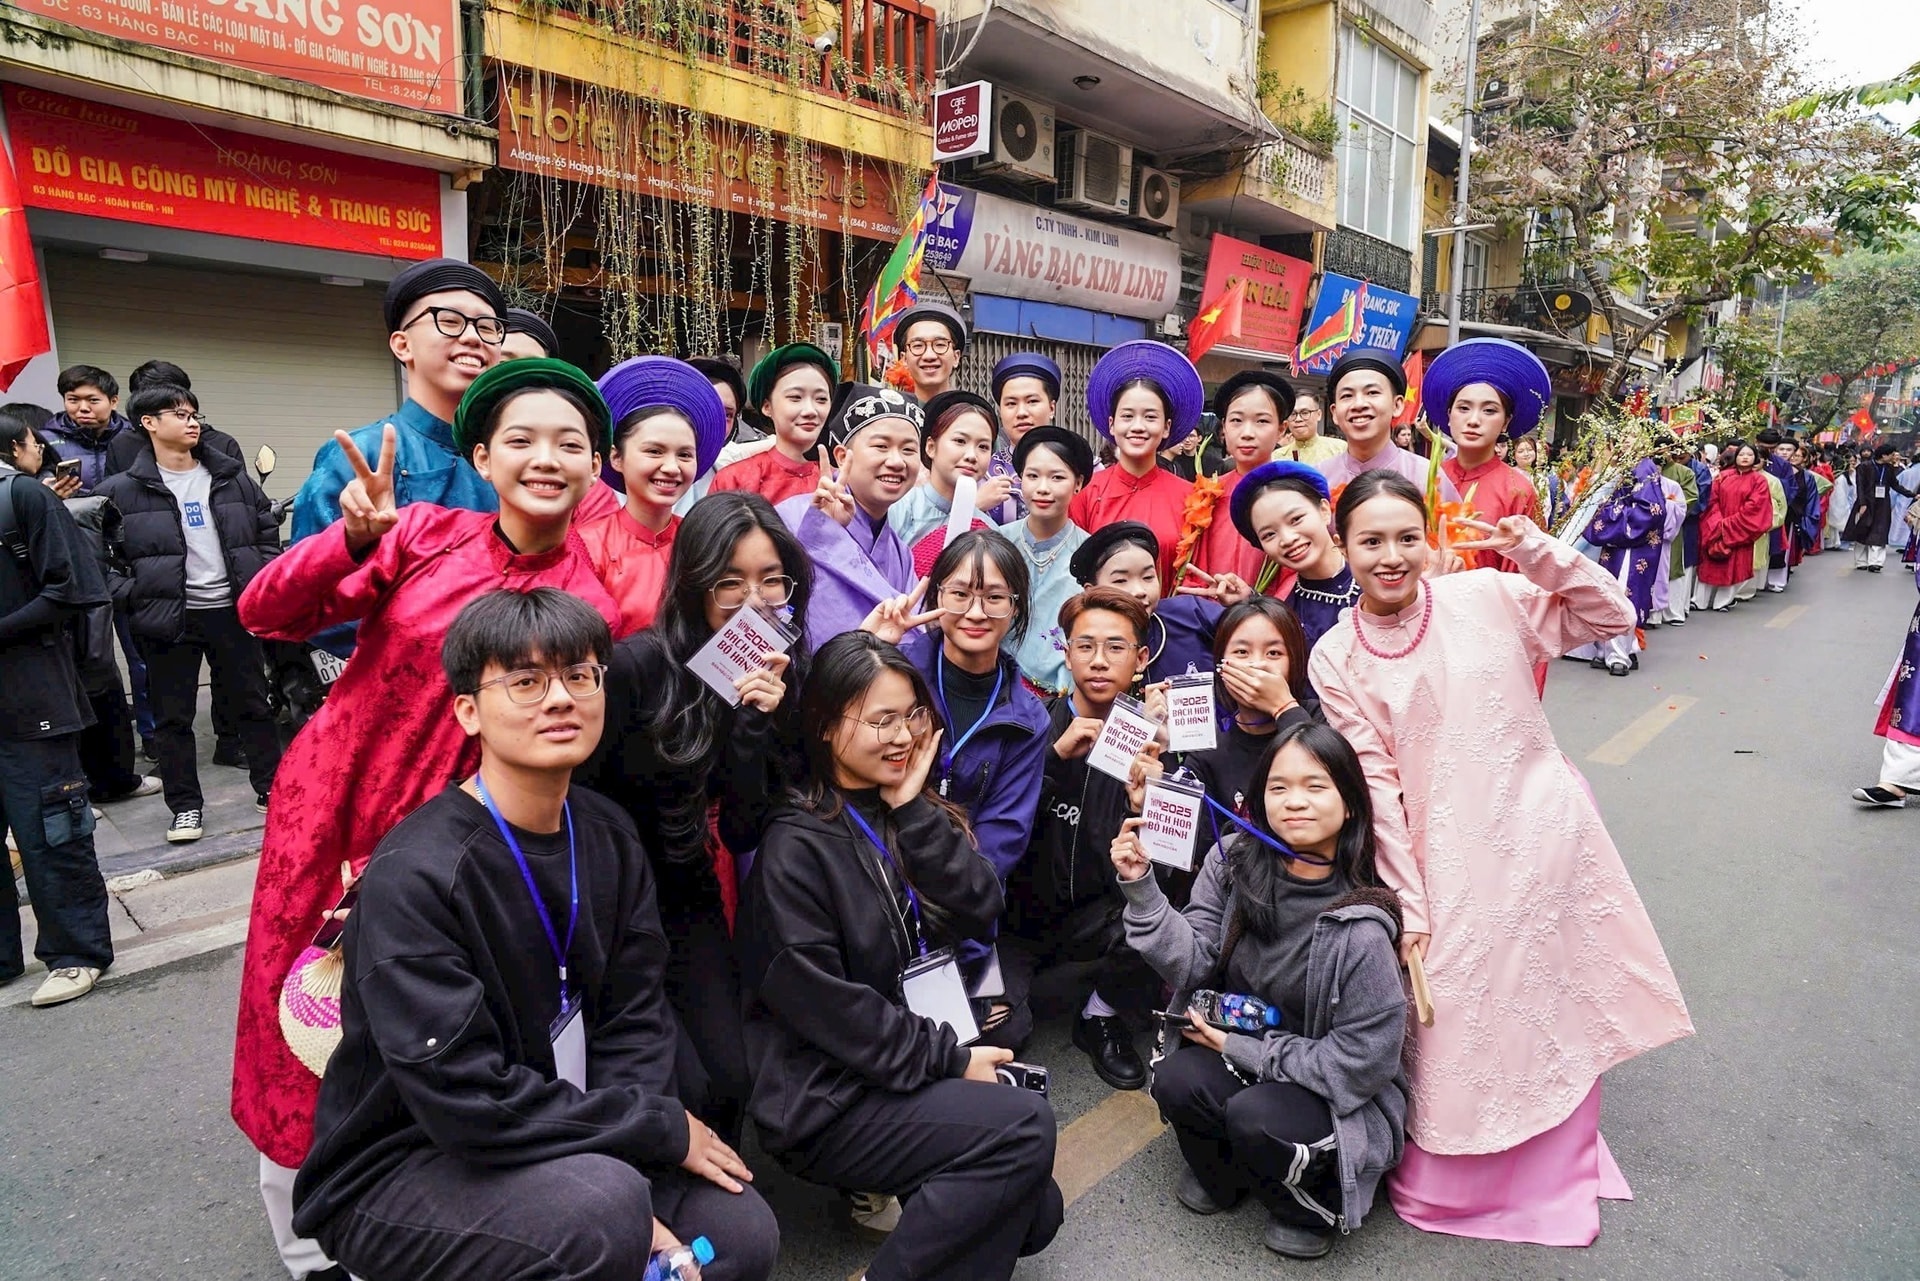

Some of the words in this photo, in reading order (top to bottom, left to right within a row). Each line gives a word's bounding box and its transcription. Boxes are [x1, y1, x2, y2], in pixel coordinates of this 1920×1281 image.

[108, 11, 158, 36] HÀNG
[165, 27, 199, 47] BẠC
[214, 39, 235, 55] HN
[162, 1, 185, 24] BÁN
[187, 3, 200, 28] LẺ
[202, 12, 223, 34] CÁC
[225, 19, 247, 45] LOẠI
[250, 25, 271, 49] MẶT
[273, 31, 286, 51] ĐÁ
[310, 41, 325, 61] GIA
[326, 44, 350, 67] CÔNG
[351, 50, 365, 71] MỸ
[391, 63, 397, 78] &
[399, 65, 424, 86] TRANG
[357, 4, 442, 65] SƠN
[364, 76, 386, 93] TEL
[216, 147, 292, 179] HOÀNG
[299, 162, 337, 185] SƠN
[568, 160, 594, 176] Hang
[648, 176, 673, 189] Hanoi
[33, 145, 71, 178] ĐỒ
[79, 155, 125, 187] GIA
[131, 163, 198, 199] CÔNG
[204, 177, 239, 205] MỸ
[244, 184, 300, 220] NGHỆ
[308, 195, 323, 217] &
[330, 198, 391, 228] TRANG
[396, 207, 432, 234] SỨC
[33, 185, 46, 196] 63
[48, 185, 75, 201] HÀNG
[77, 191, 97, 204] BẠC
[161, 205, 175, 216] HN
[937, 235, 959, 252] BẠC
[1036, 216, 1055, 231] C.TY
[1057, 221, 1078, 239] TNHH
[1085, 228, 1101, 244] KIM
[1102, 232, 1120, 248] LINH
[984, 224, 1044, 279] VÀNG
[1044, 246, 1086, 291] BẠC
[1085, 255, 1125, 294] KIM
[1124, 263, 1168, 302] LINH
[1225, 274, 1259, 304] SN
[1367, 322, 1401, 351] THÊM
[723, 629, 750, 653] BÁCH
[1182, 696, 1208, 706] 2025
[1194, 706, 1210, 716] HOA
[1121, 722, 1149, 741] 2025
[1160, 801, 1192, 818] 2025
[1173, 817, 1192, 830] HOA
